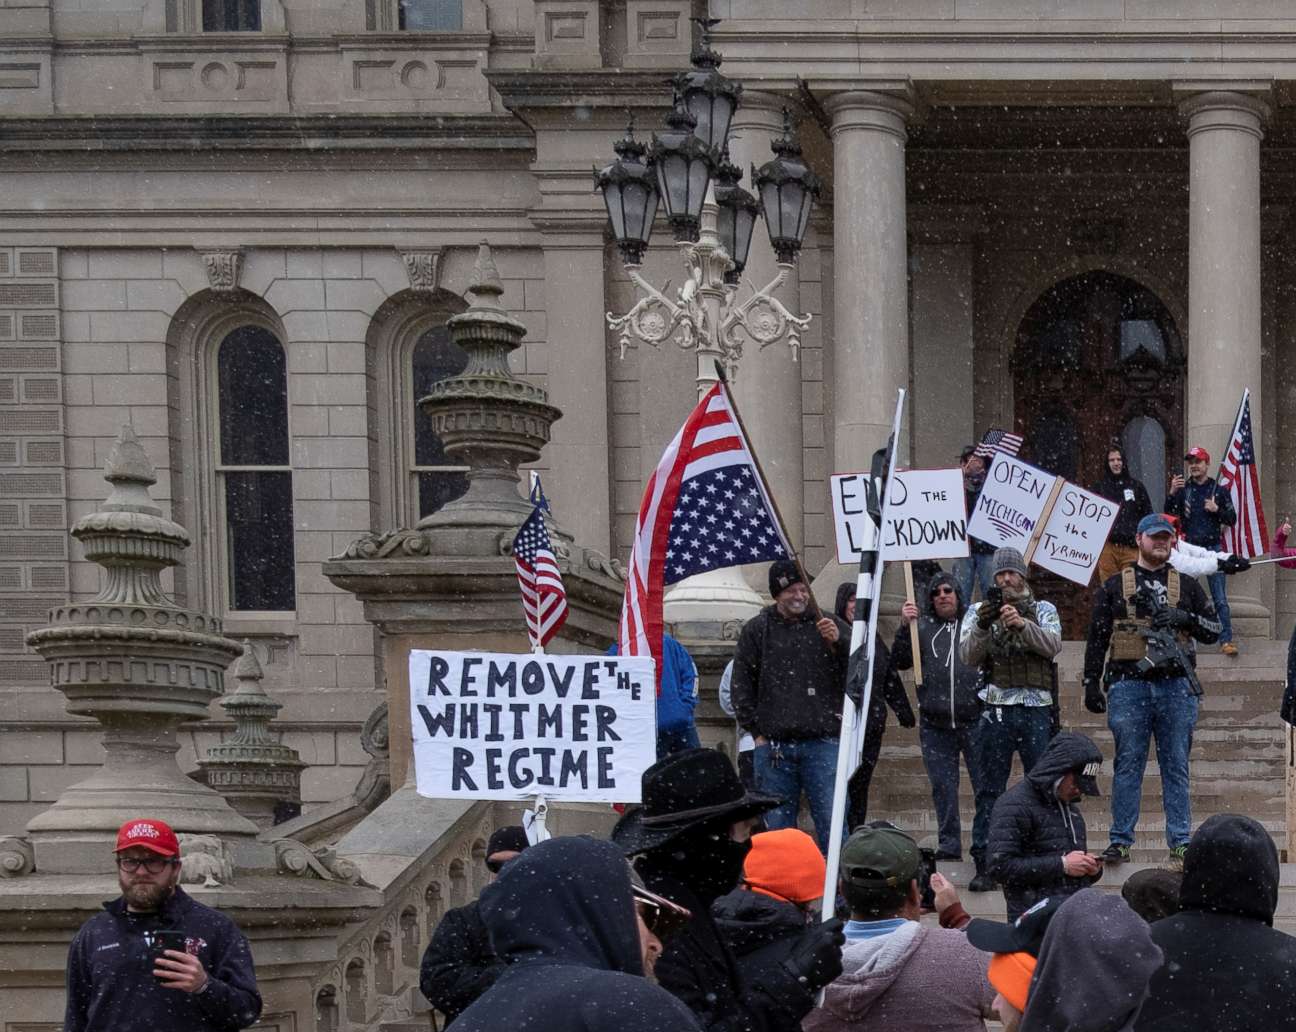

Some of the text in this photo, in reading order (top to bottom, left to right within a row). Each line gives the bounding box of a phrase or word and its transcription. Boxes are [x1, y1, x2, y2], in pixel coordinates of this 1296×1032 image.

[921, 490, 948, 503] THE
[994, 461, 1046, 500] OPEN
[979, 494, 1037, 532] MICHIGAN
[1061, 491, 1112, 523] STOP
[845, 517, 967, 554] LKDOWN
[1064, 522, 1088, 540] the
[427, 656, 642, 701] REMOVE THE
[416, 703, 622, 742] WHITMER
[451, 746, 616, 791] REGIME
